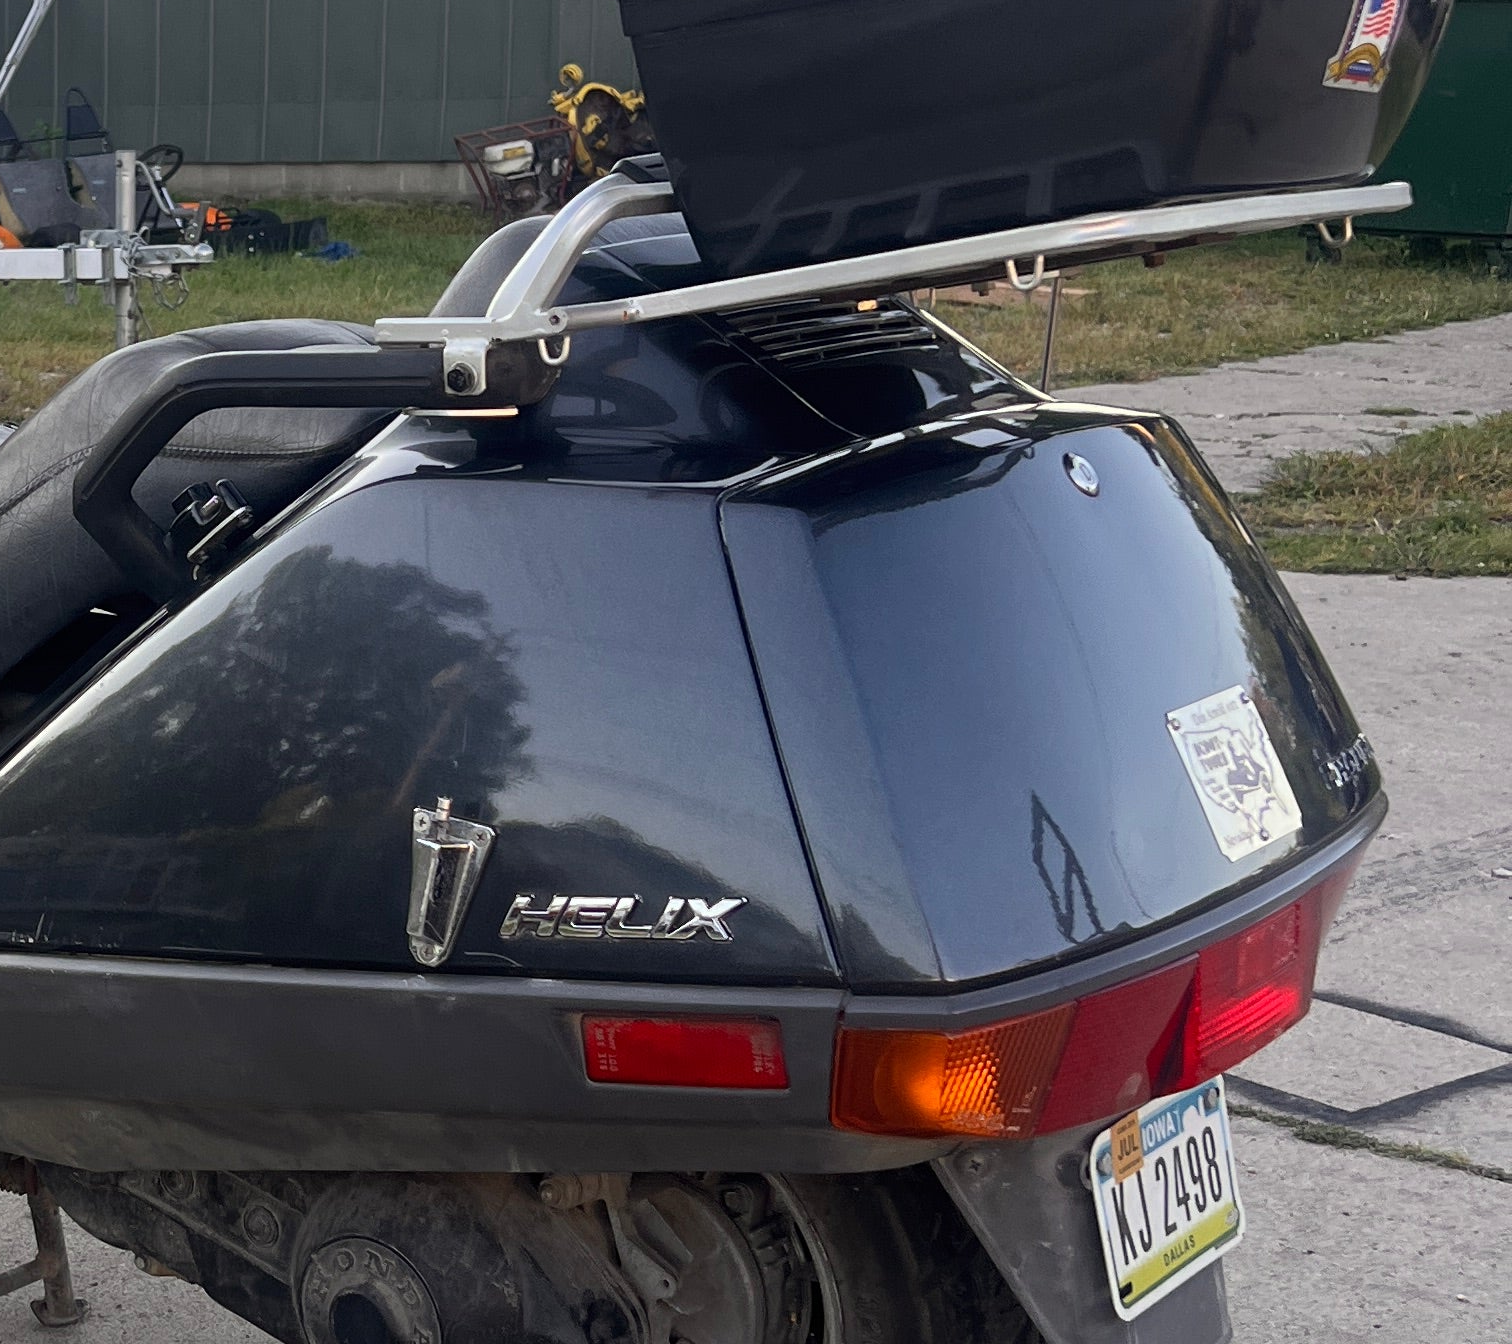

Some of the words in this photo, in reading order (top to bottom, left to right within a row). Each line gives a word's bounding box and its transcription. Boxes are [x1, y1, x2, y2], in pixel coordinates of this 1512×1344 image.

[499, 893, 750, 942] HELIX
[1117, 1133, 1139, 1161] JUL
[1141, 1111, 1176, 1150] IOWA
[1111, 1170, 1152, 1265] KJ
[1155, 1126, 1222, 1237] 2498
[1162, 1234, 1196, 1267] DALLAS
